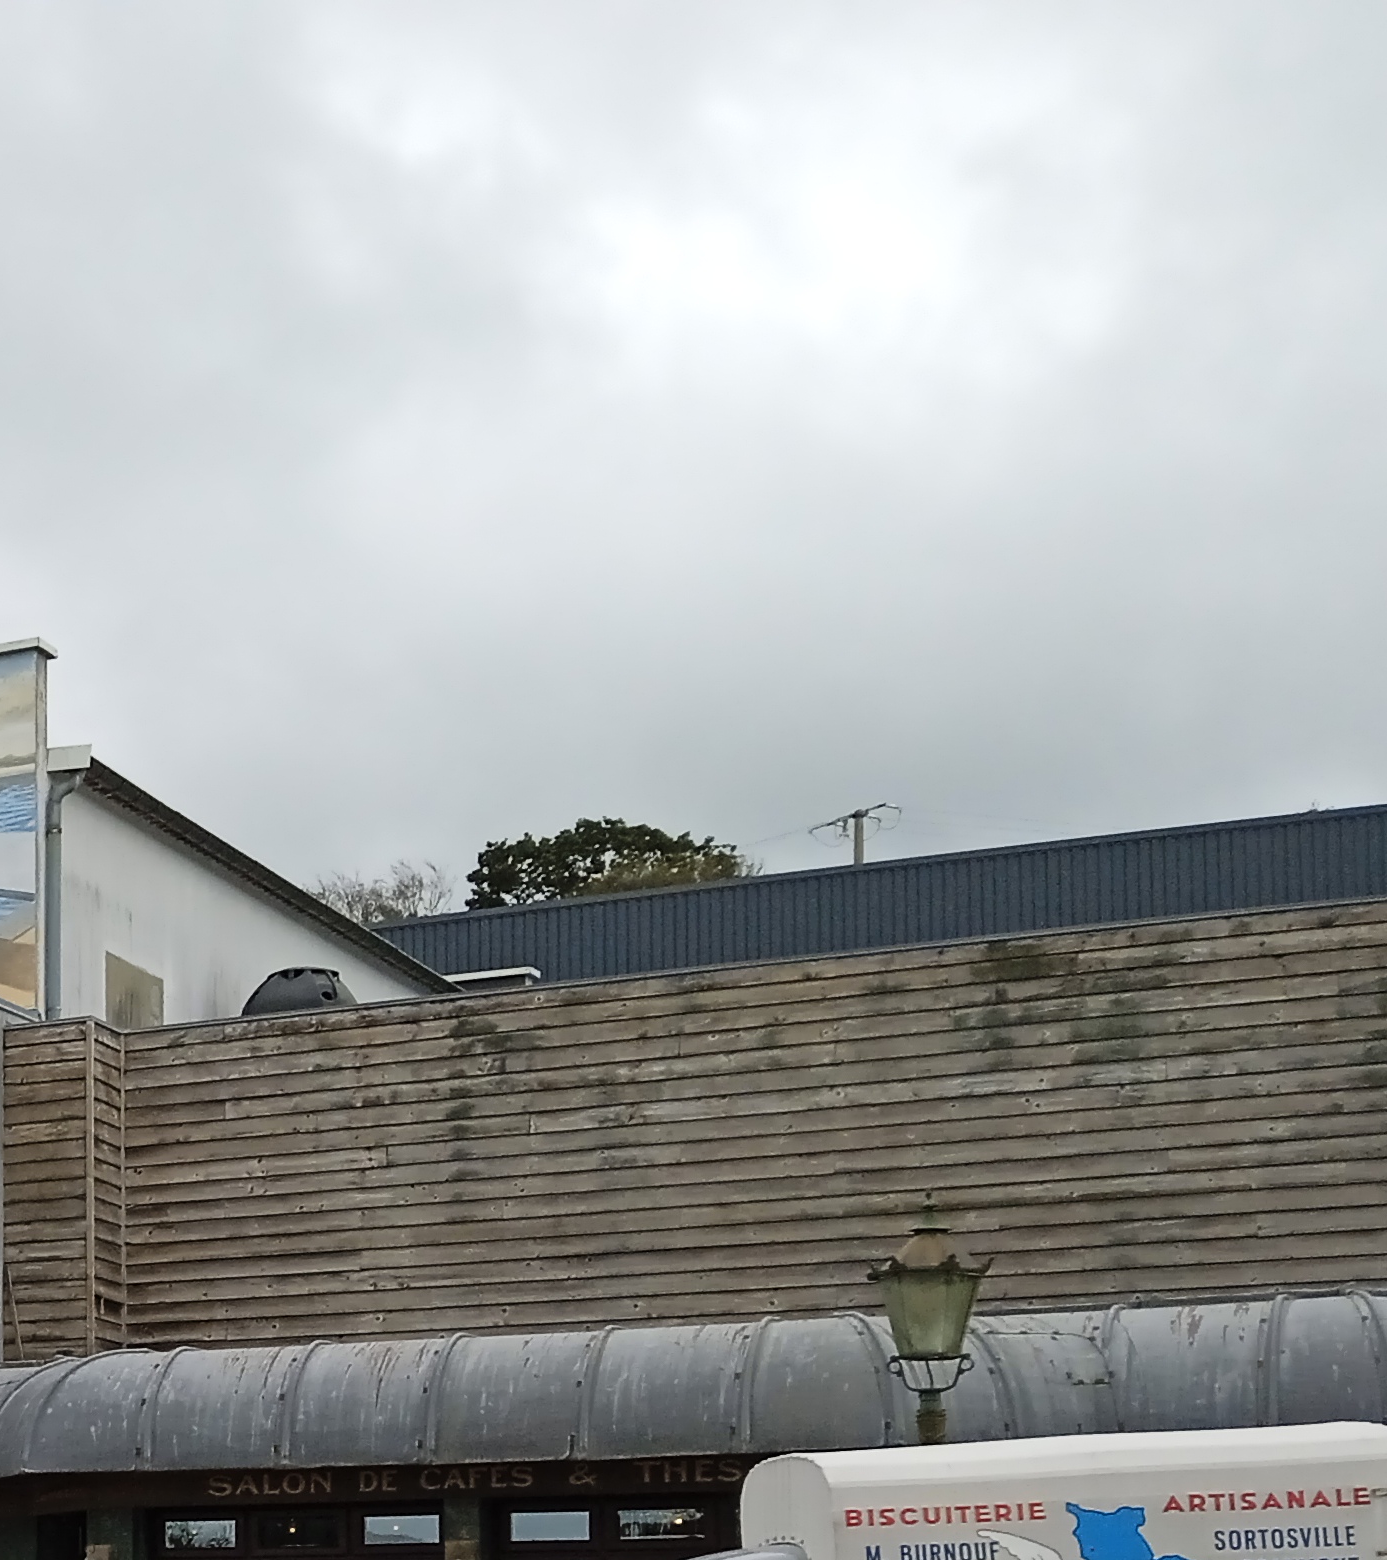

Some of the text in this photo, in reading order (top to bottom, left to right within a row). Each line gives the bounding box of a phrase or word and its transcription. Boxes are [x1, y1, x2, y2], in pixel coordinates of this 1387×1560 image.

[207, 1472, 332, 1497] SALON
[359, 1470, 398, 1492] DE
[568, 1463, 597, 1486] &
[844, 1487, 1372, 1528] BISCUITERIE ARTISANALE
[1213, 1525, 1357, 1551] SORTOSVILLE
